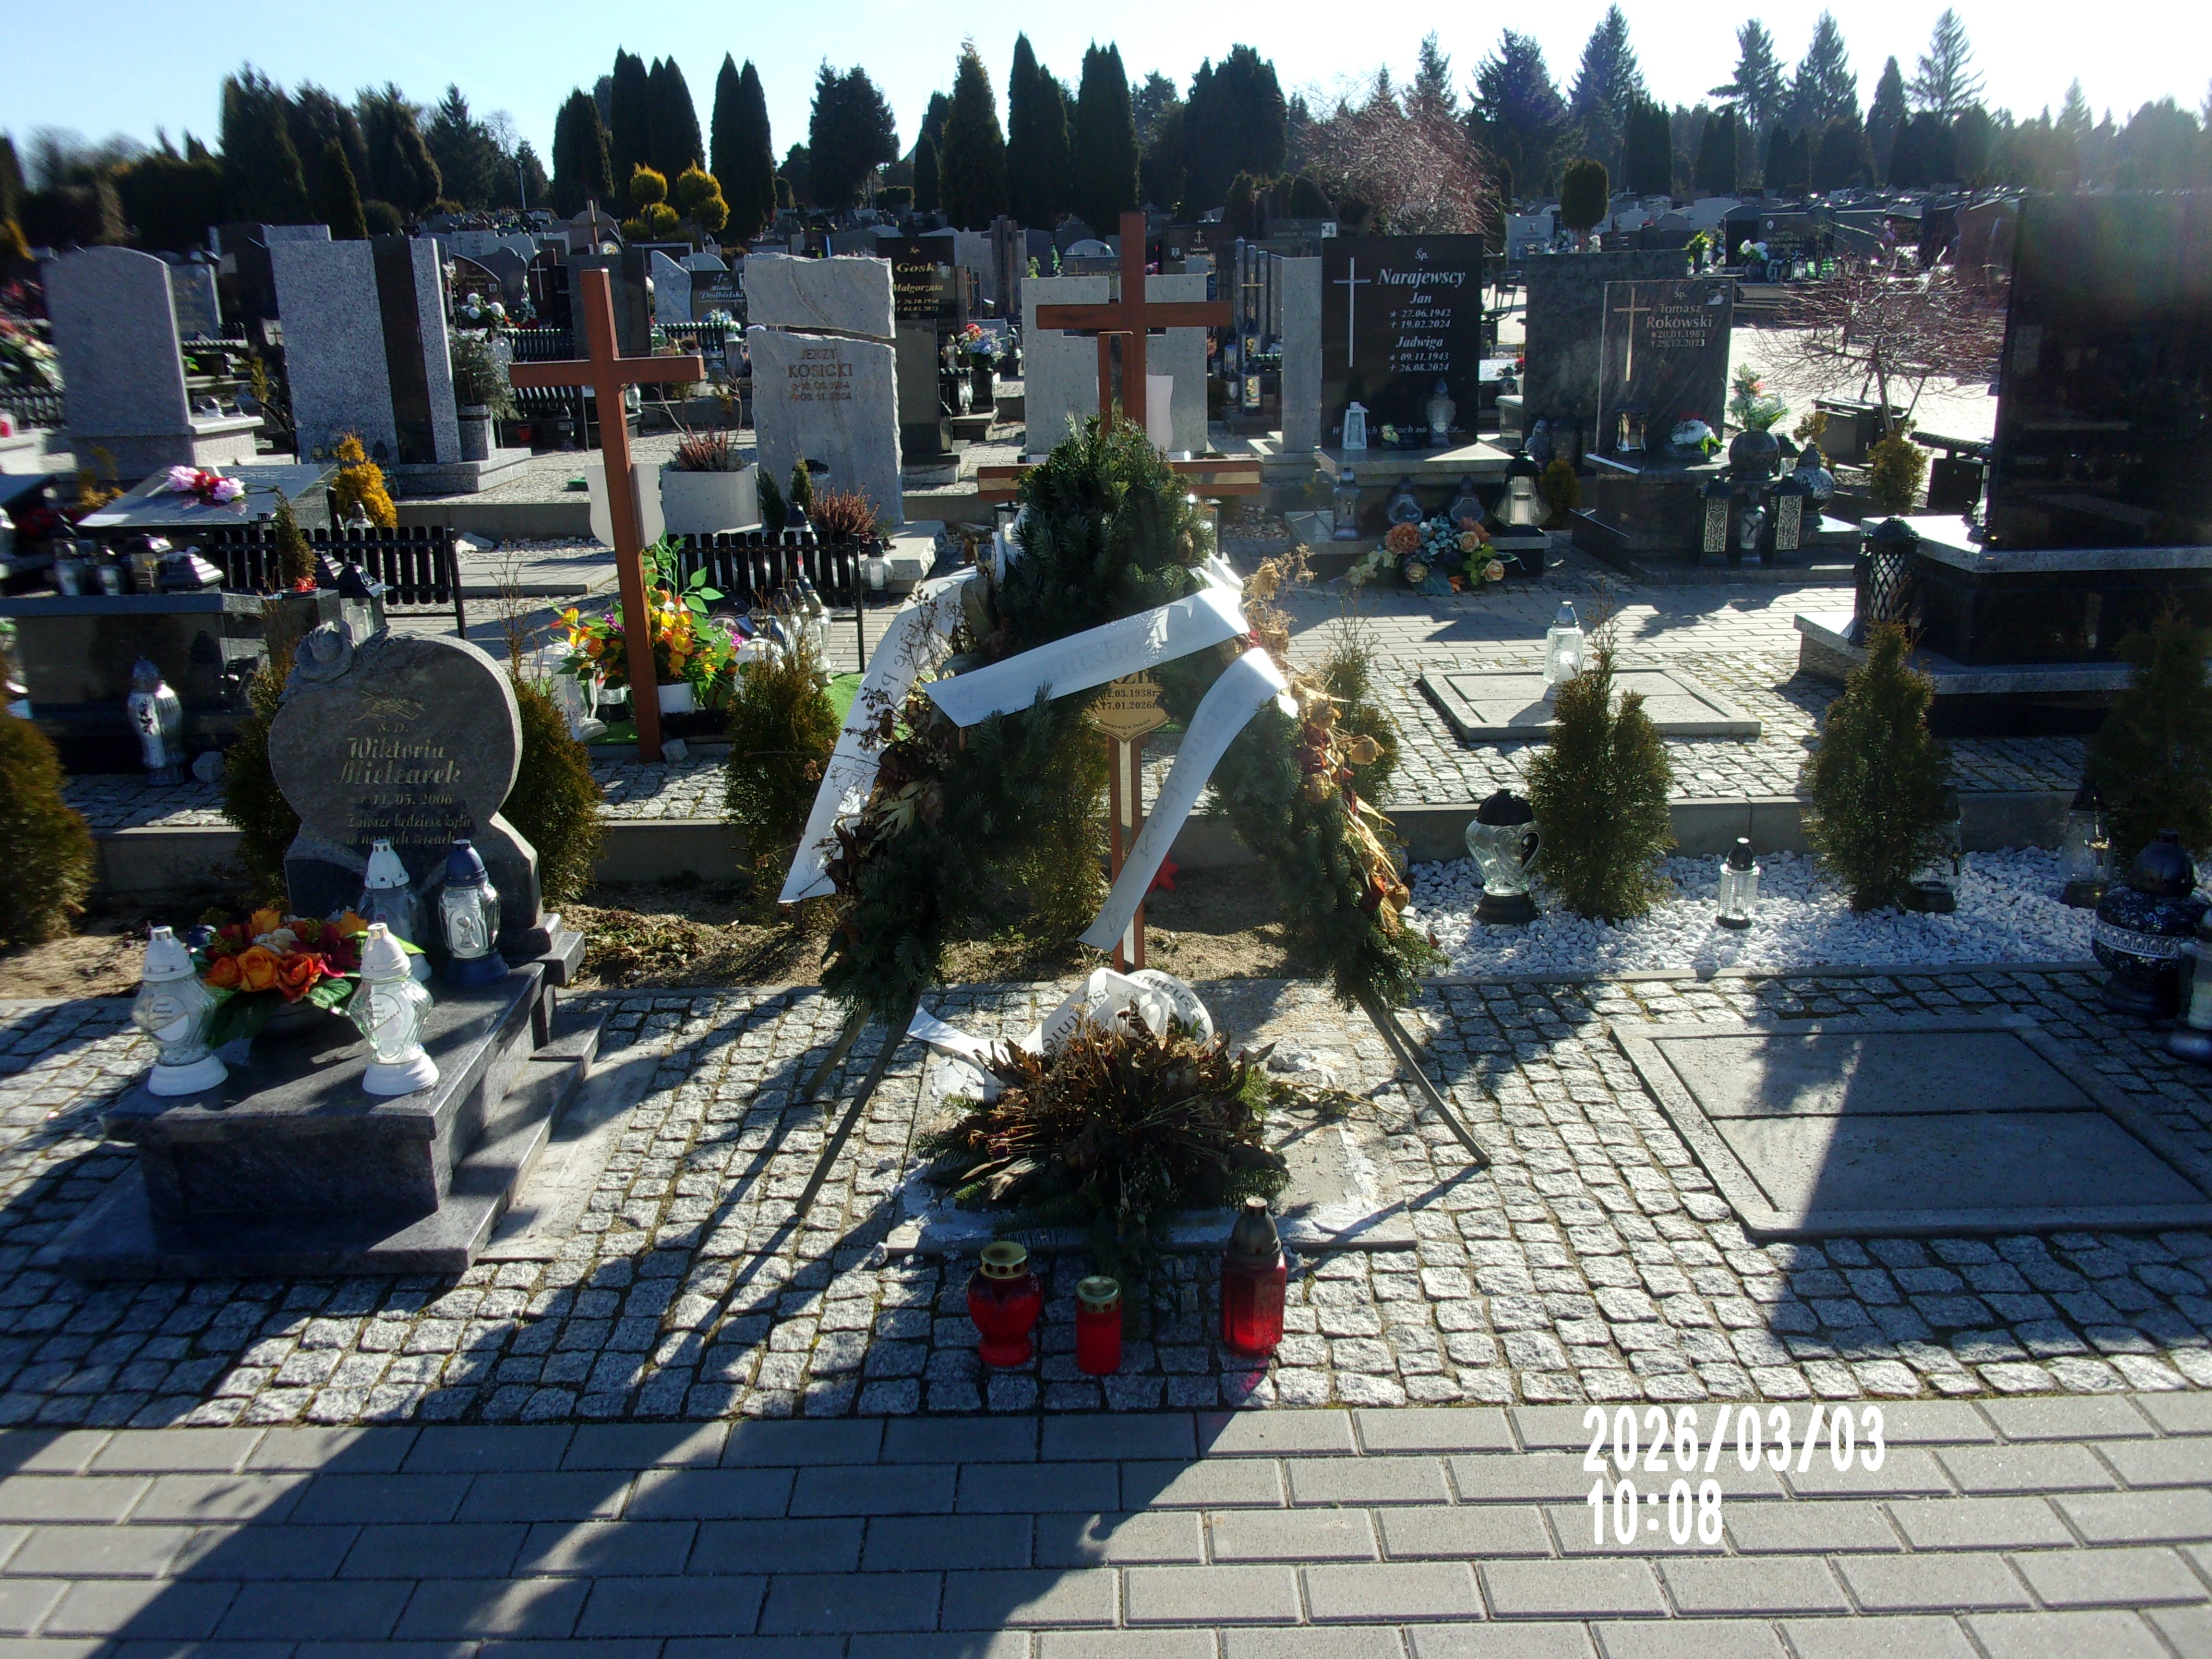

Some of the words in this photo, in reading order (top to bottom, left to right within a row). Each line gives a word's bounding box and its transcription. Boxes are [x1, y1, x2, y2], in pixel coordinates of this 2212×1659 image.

[896, 262, 936, 273] Gosk
[1377, 267, 1466, 289] Narajewscy
[1409, 292, 1432, 304] Jan
[1401, 309, 1451, 318] 27.06.1942
[1659, 303, 1702, 313] Tomasz
[1401, 319, 1451, 329] 19.02.2024
[1646, 314, 1712, 329] Rokowski
[1395, 336, 1443, 350] Jadwiga
[1400, 352, 1449, 361] 09.11.1943
[787, 363, 853, 378] KOSICKI
[1399, 363, 1450, 372] 26.08.2024
[347, 737, 445, 759] Wiktoria
[340, 759, 462, 784] Mielcarek
[421, 793, 453, 805] 2006
